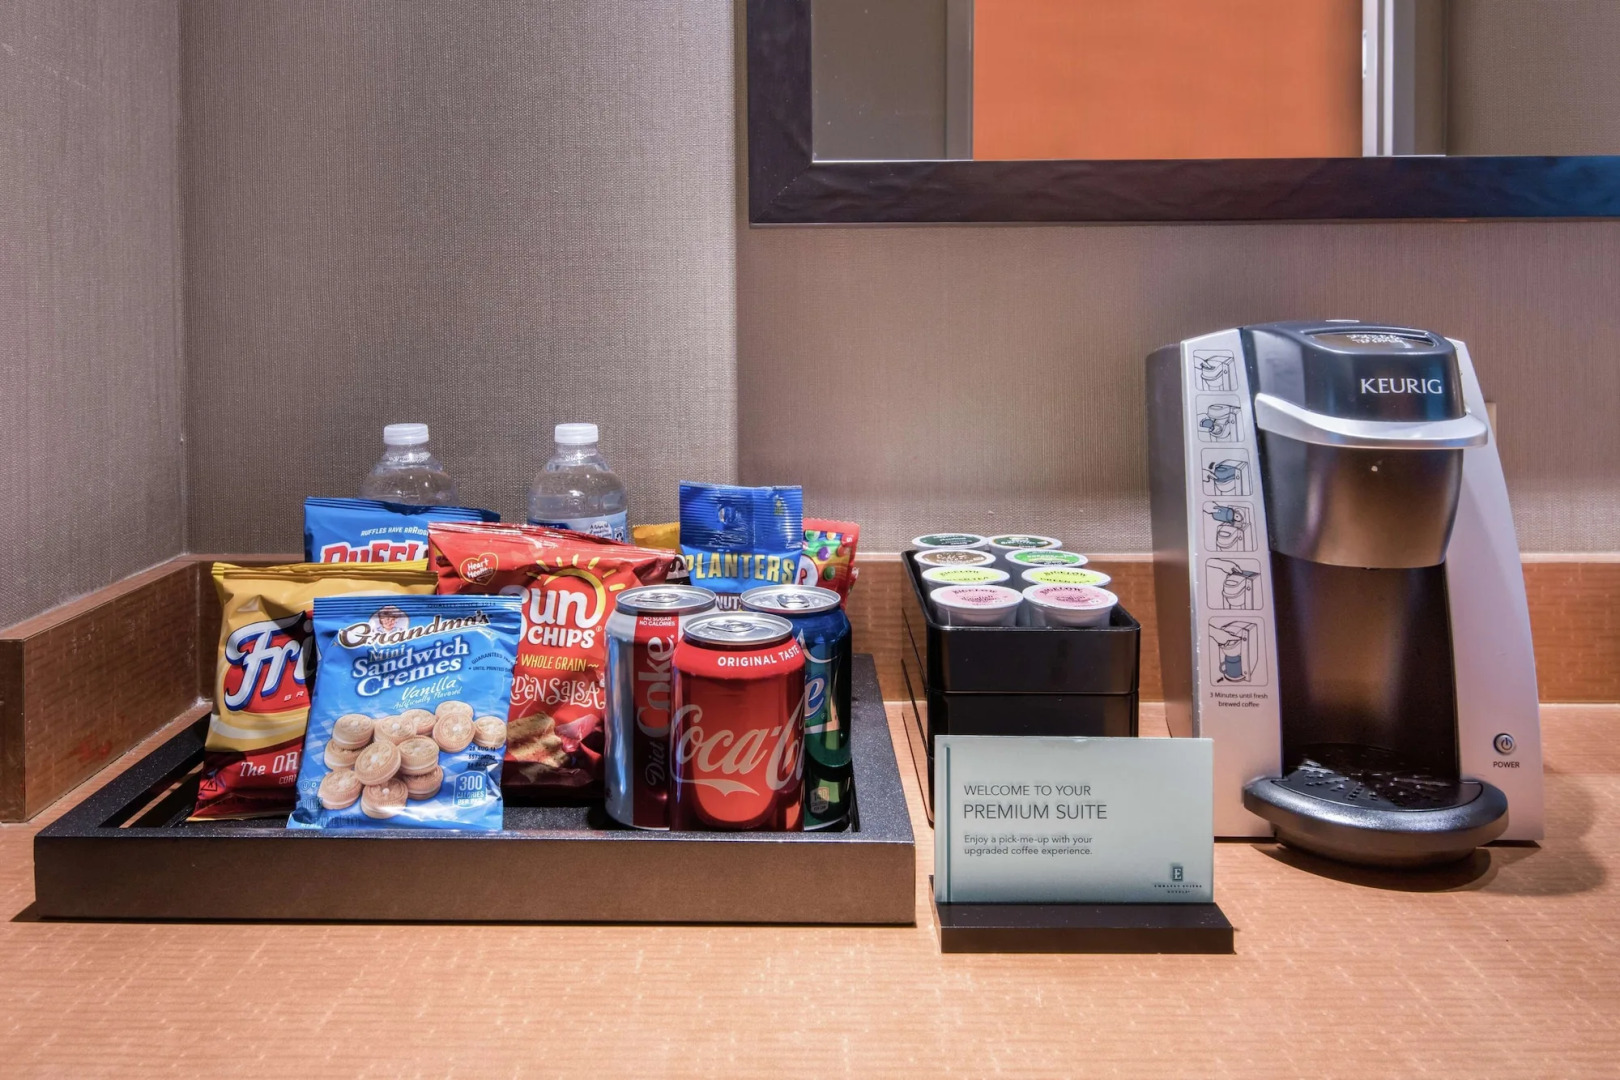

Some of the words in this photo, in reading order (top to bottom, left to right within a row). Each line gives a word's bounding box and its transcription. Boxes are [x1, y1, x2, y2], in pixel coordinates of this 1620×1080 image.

[1360, 378, 1443, 394] KEURIG
[360, 527, 387, 537] RUFFLES
[388, 526, 402, 534] HAVE
[467, 557, 489, 570] Heart
[685, 552, 795, 584] PLANTERS
[715, 595, 742, 610] NUT
[338, 610, 492, 649] Grandma's
[527, 625, 596, 649] CHIPS
[225, 609, 314, 711] Fri
[352, 635, 470, 678] Sandwich
[369, 645, 406, 663] Mini
[521, 653, 554, 669] WHOLE
[555, 656, 587, 672] GRAIN
[717, 654, 777, 667] ORIGINAL
[778, 644, 800, 662] TASTE
[357, 656, 463, 697] Cremes
[401, 676, 457, 701] Vanilla
[240, 762, 266, 777] The
[272, 751, 299, 774] OR
[645, 742, 665, 786] Diet
[459, 775, 483, 791] 300
[963, 785, 1031, 796] WELCOME
[1034, 785, 1052, 796] TO
[1055, 785, 1092, 796] YOUR
[963, 804, 1049, 819] PREMIUM
[1056, 804, 1108, 819] SUITE
[964, 834, 989, 845] Enjoy
[999, 834, 1050, 845] pick-me-up
[1051, 834, 1070, 844] with
[1072, 837, 1093, 845] your
[964, 846, 1009, 857] upgraded
[1010, 846, 1039, 855] coffee
[1041, 846, 1093, 857] experience.
